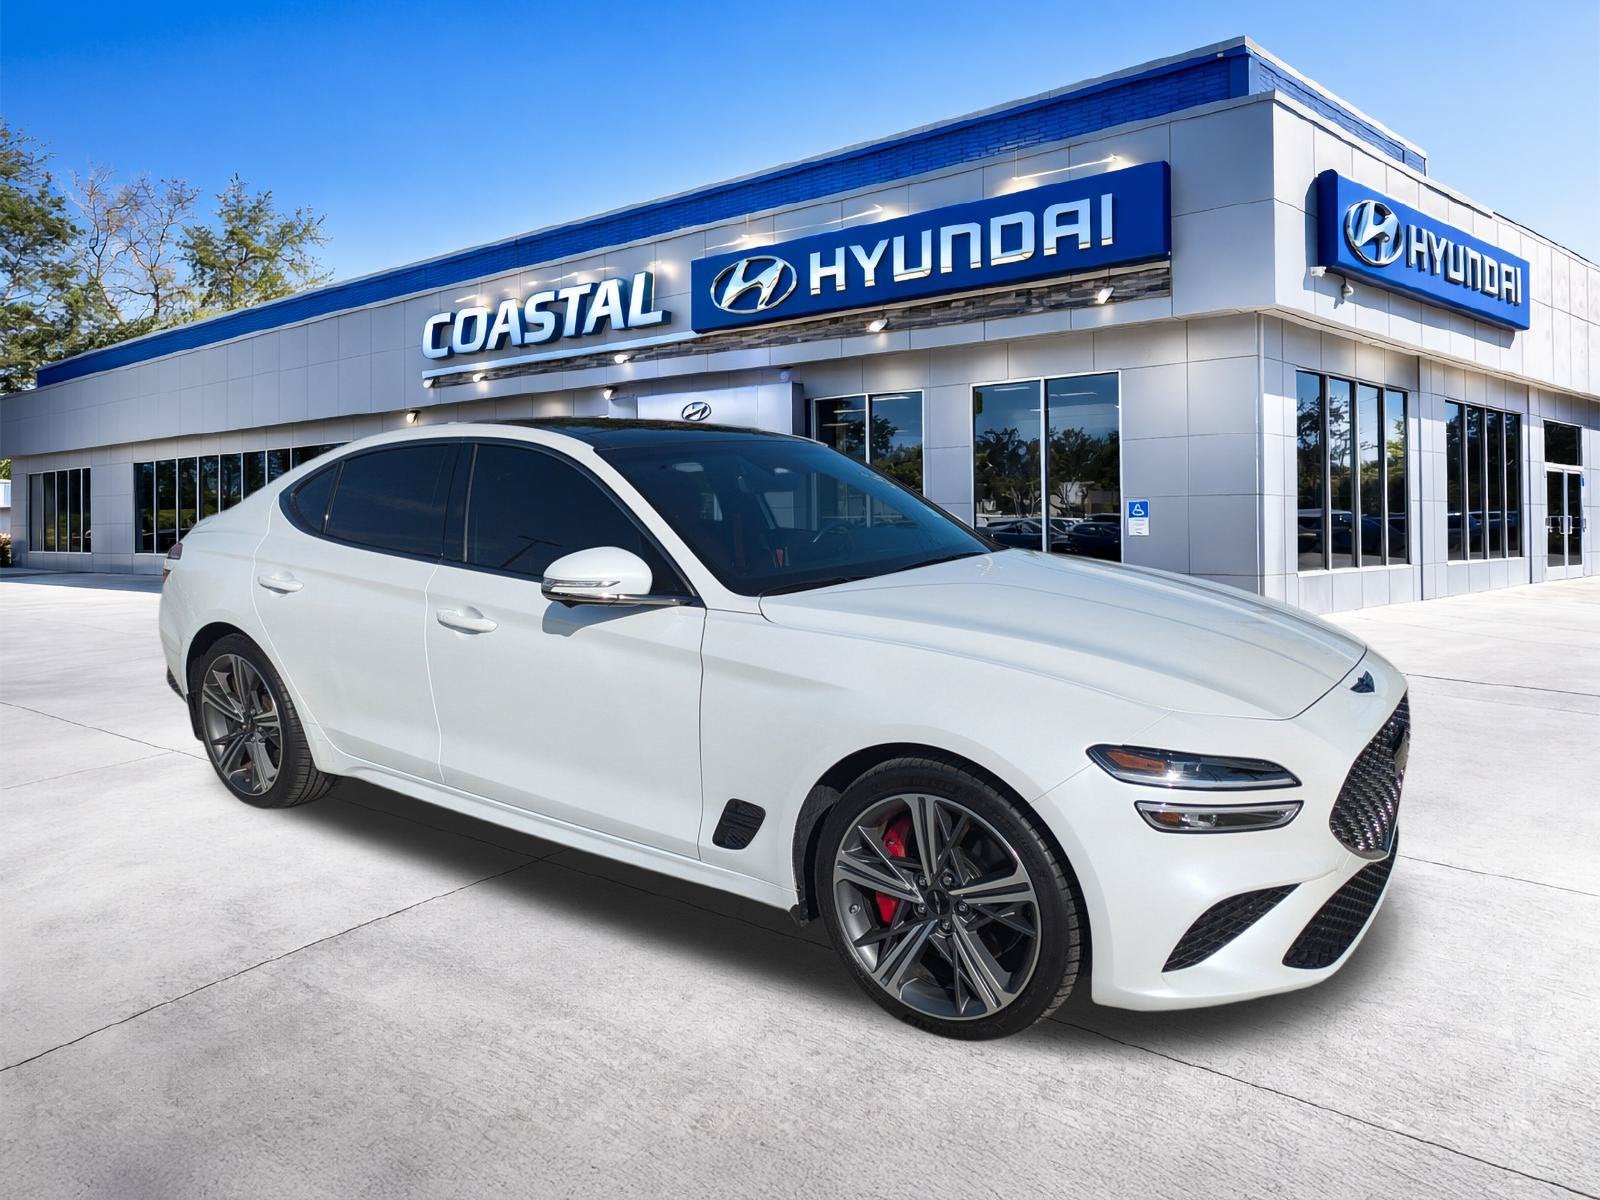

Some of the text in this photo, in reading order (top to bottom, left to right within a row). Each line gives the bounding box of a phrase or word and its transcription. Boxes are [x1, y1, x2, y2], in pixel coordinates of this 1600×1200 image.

[810, 193, 1113, 295] HYUNDAI
[1407, 224, 1521, 306] HYUNDAI
[422, 271, 668, 359] COASTAL
